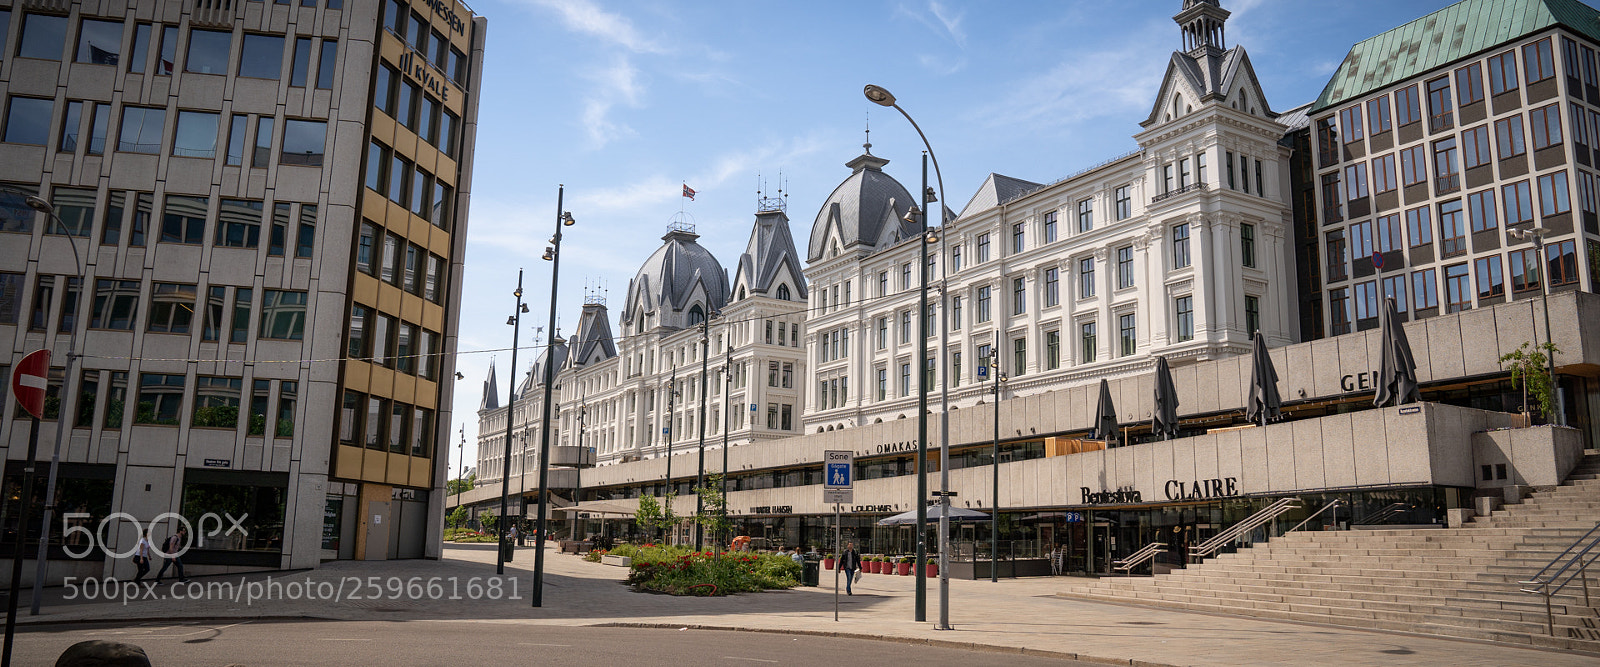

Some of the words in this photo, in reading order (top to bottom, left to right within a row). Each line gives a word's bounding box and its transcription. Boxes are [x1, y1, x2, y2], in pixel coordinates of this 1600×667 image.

[415, 64, 449, 101] KVALE
[1341, 370, 1379, 391] GE
[876, 440, 918, 454] OMAKAS
[1164, 476, 1239, 501] CLAIRE
[771, 505, 793, 514] HANSEN
